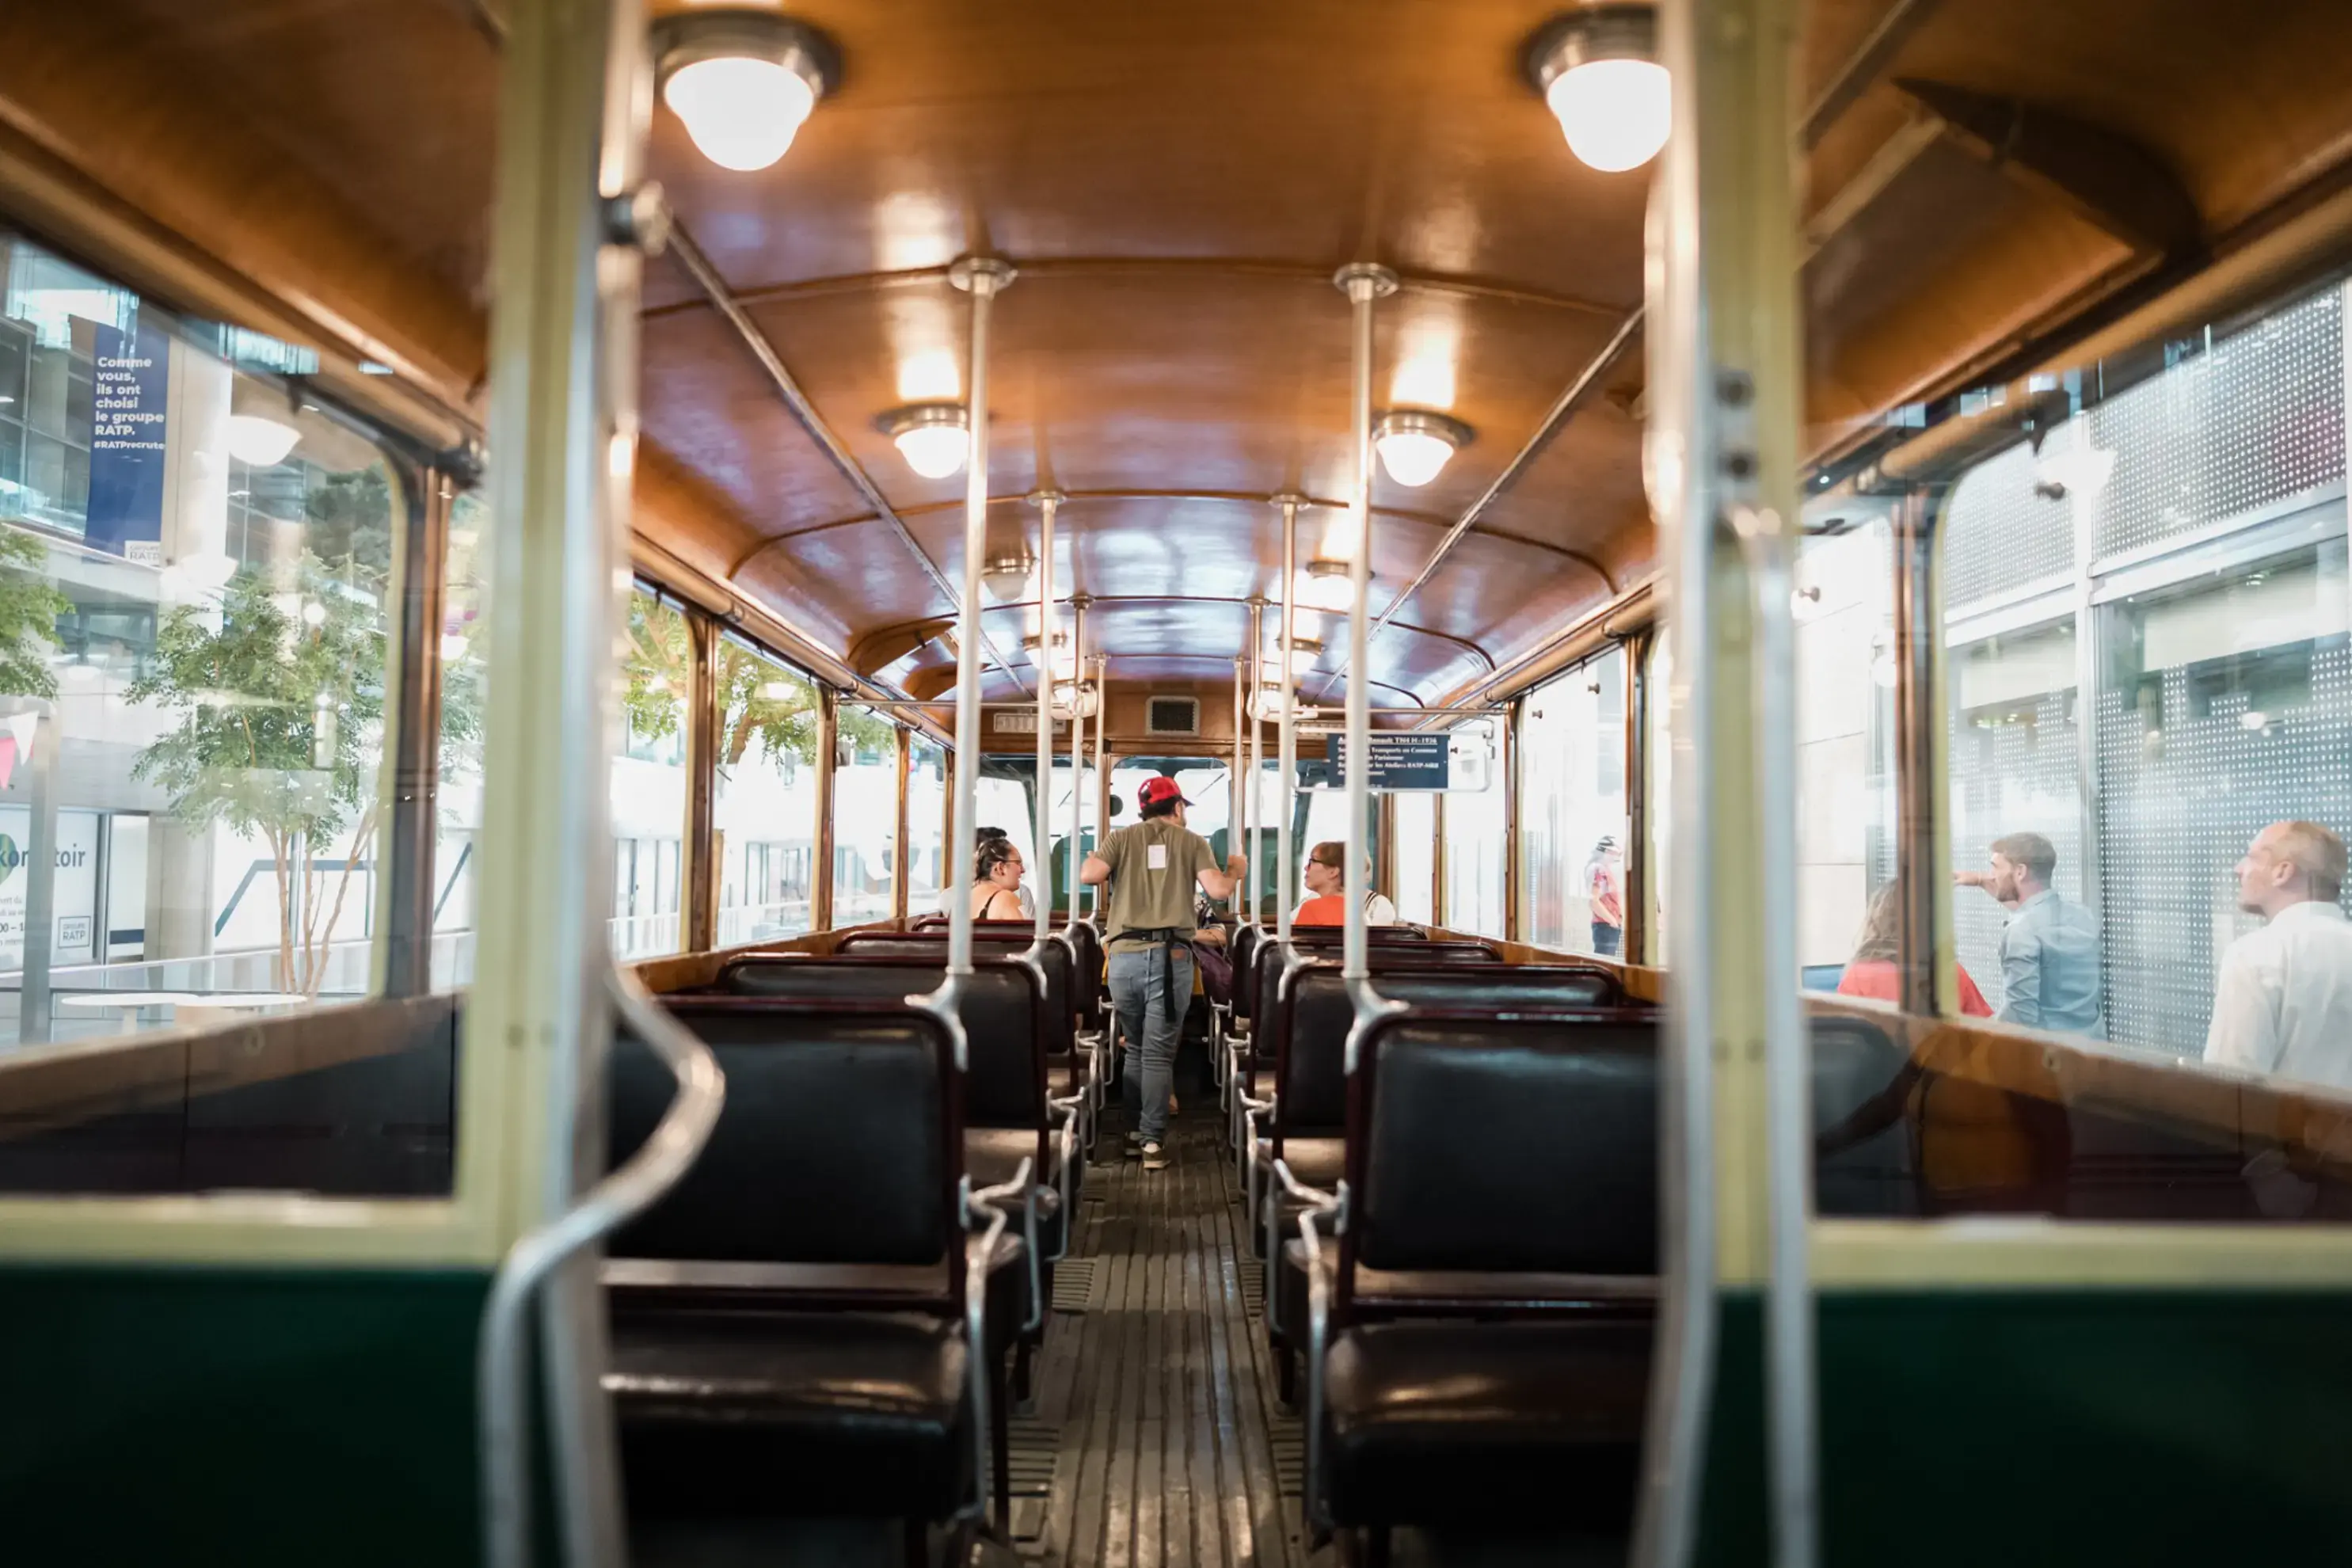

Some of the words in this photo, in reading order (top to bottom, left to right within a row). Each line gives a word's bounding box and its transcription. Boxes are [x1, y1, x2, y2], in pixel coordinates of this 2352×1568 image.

[97, 356, 153, 367] Comme
[96, 371, 136, 383] vous,
[96, 382, 112, 395] ils
[116, 384, 141, 395] ont
[95, 396, 139, 409] choisi
[95, 410, 108, 421] le
[112, 413, 165, 424] groupe
[94, 424, 135, 436] RATP.
[93, 440, 166, 450] #RATPrecrute
[63, 930, 86, 941] RATP
